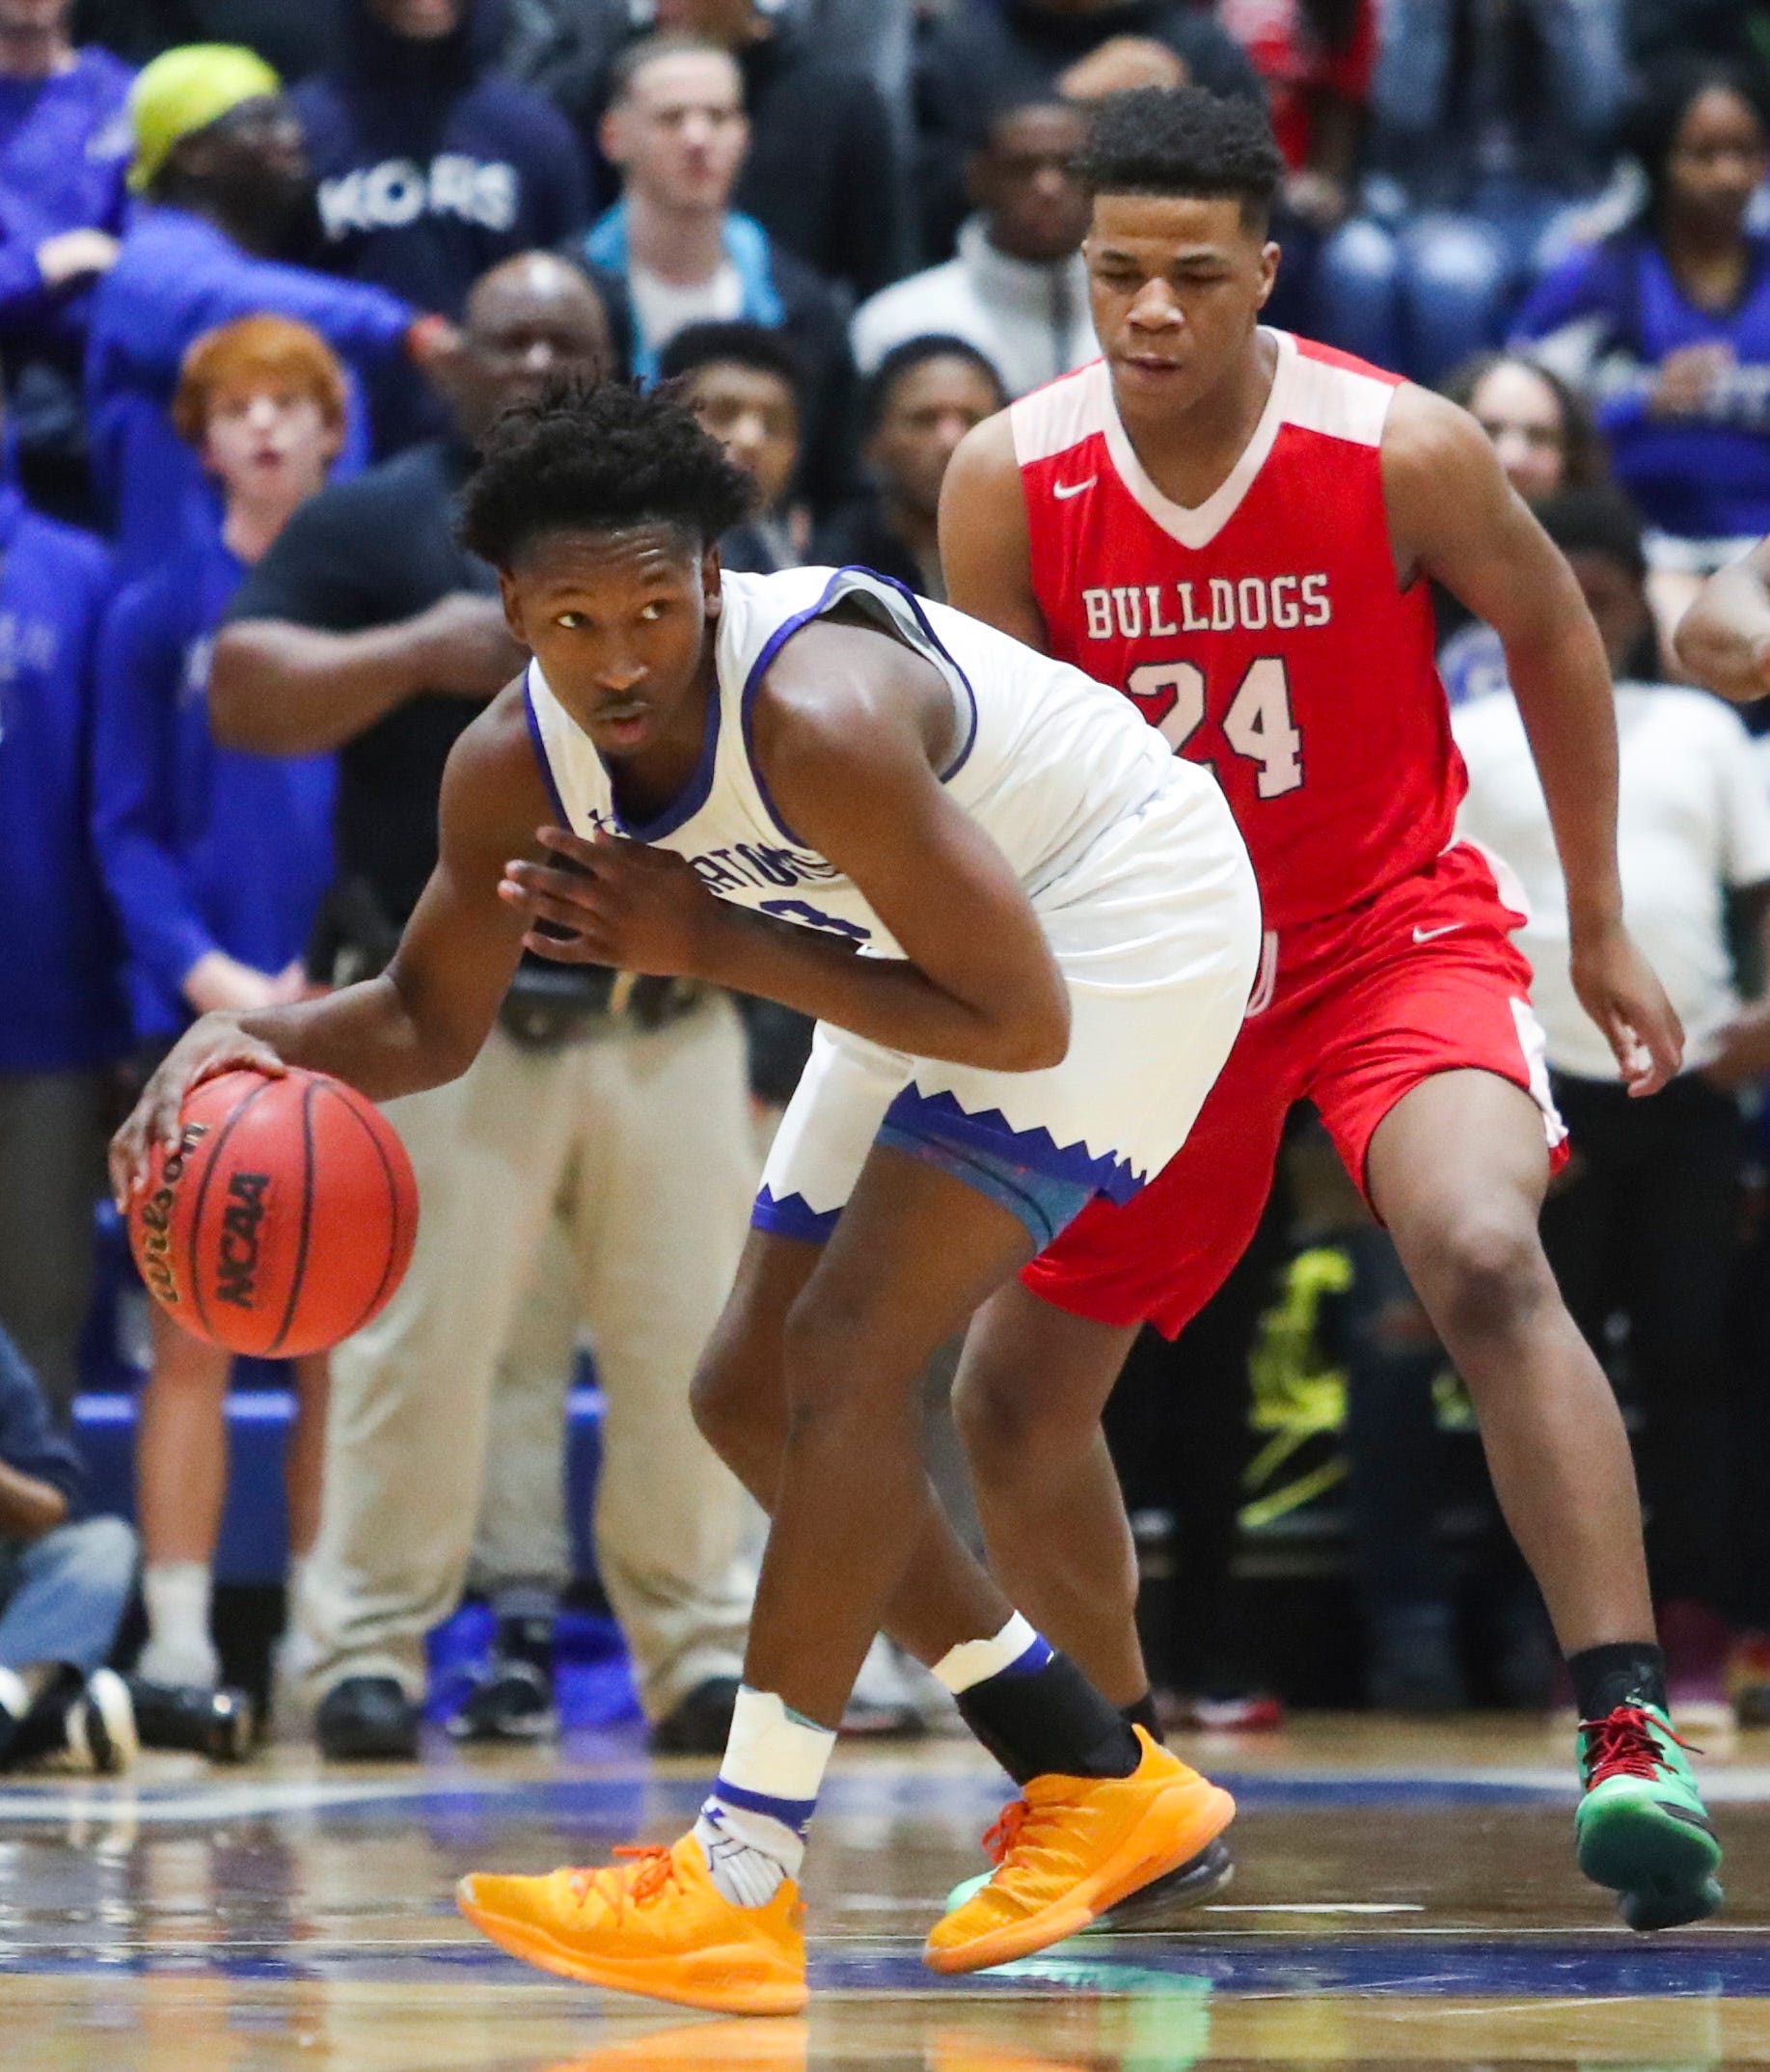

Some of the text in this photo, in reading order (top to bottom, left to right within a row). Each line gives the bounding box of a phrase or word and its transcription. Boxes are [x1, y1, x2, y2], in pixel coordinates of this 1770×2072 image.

[1081, 573, 1331, 640] BULLDOGS
[1125, 656, 1305, 801] 24
[142, 1123, 208, 1302] Wilson
[214, 1171, 271, 1310] NCAA
